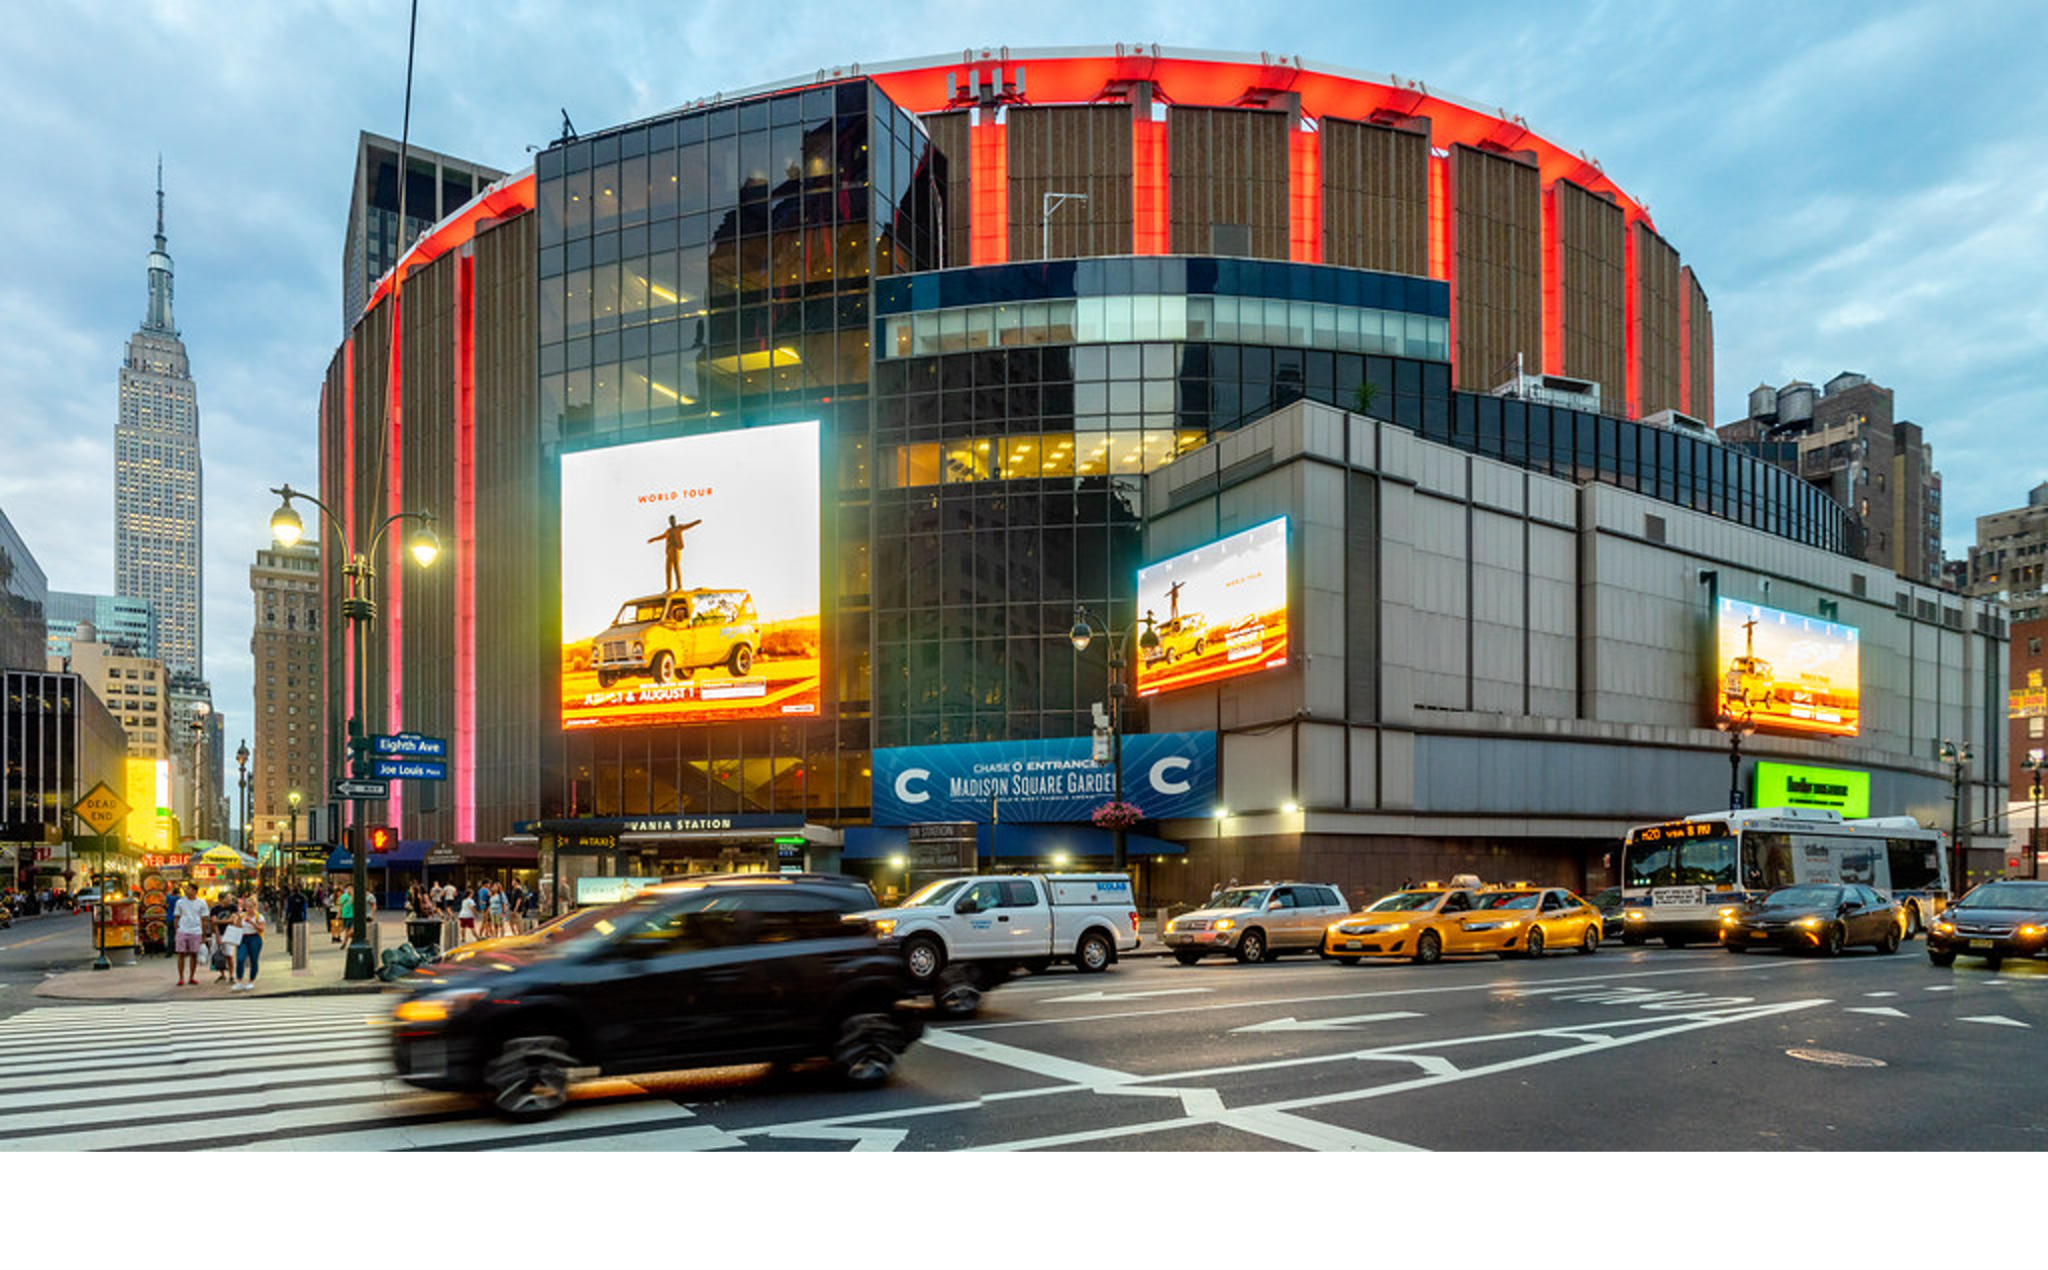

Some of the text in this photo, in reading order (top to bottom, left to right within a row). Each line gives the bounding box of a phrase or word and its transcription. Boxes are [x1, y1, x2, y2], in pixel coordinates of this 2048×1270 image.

[638, 487, 713, 503] WORLD TOUR
[640, 688, 685, 701] AUGUST
[380, 739, 440, 752] Eighth Ave
[380, 764, 397, 775] Joe
[399, 764, 424, 775] Louis
[974, 759, 1099, 774] CHASE ENTRANCE
[1149, 756, 1192, 795] C
[894, 768, 931, 804] C
[949, 777, 1008, 797] MADISON
[1012, 774, 1063, 795] SQUARE
[87, 799, 117, 809] DEAD
[92, 812, 113, 821] END
[677, 818, 731, 831] STATION
[589, 837, 608, 846] TAXI
